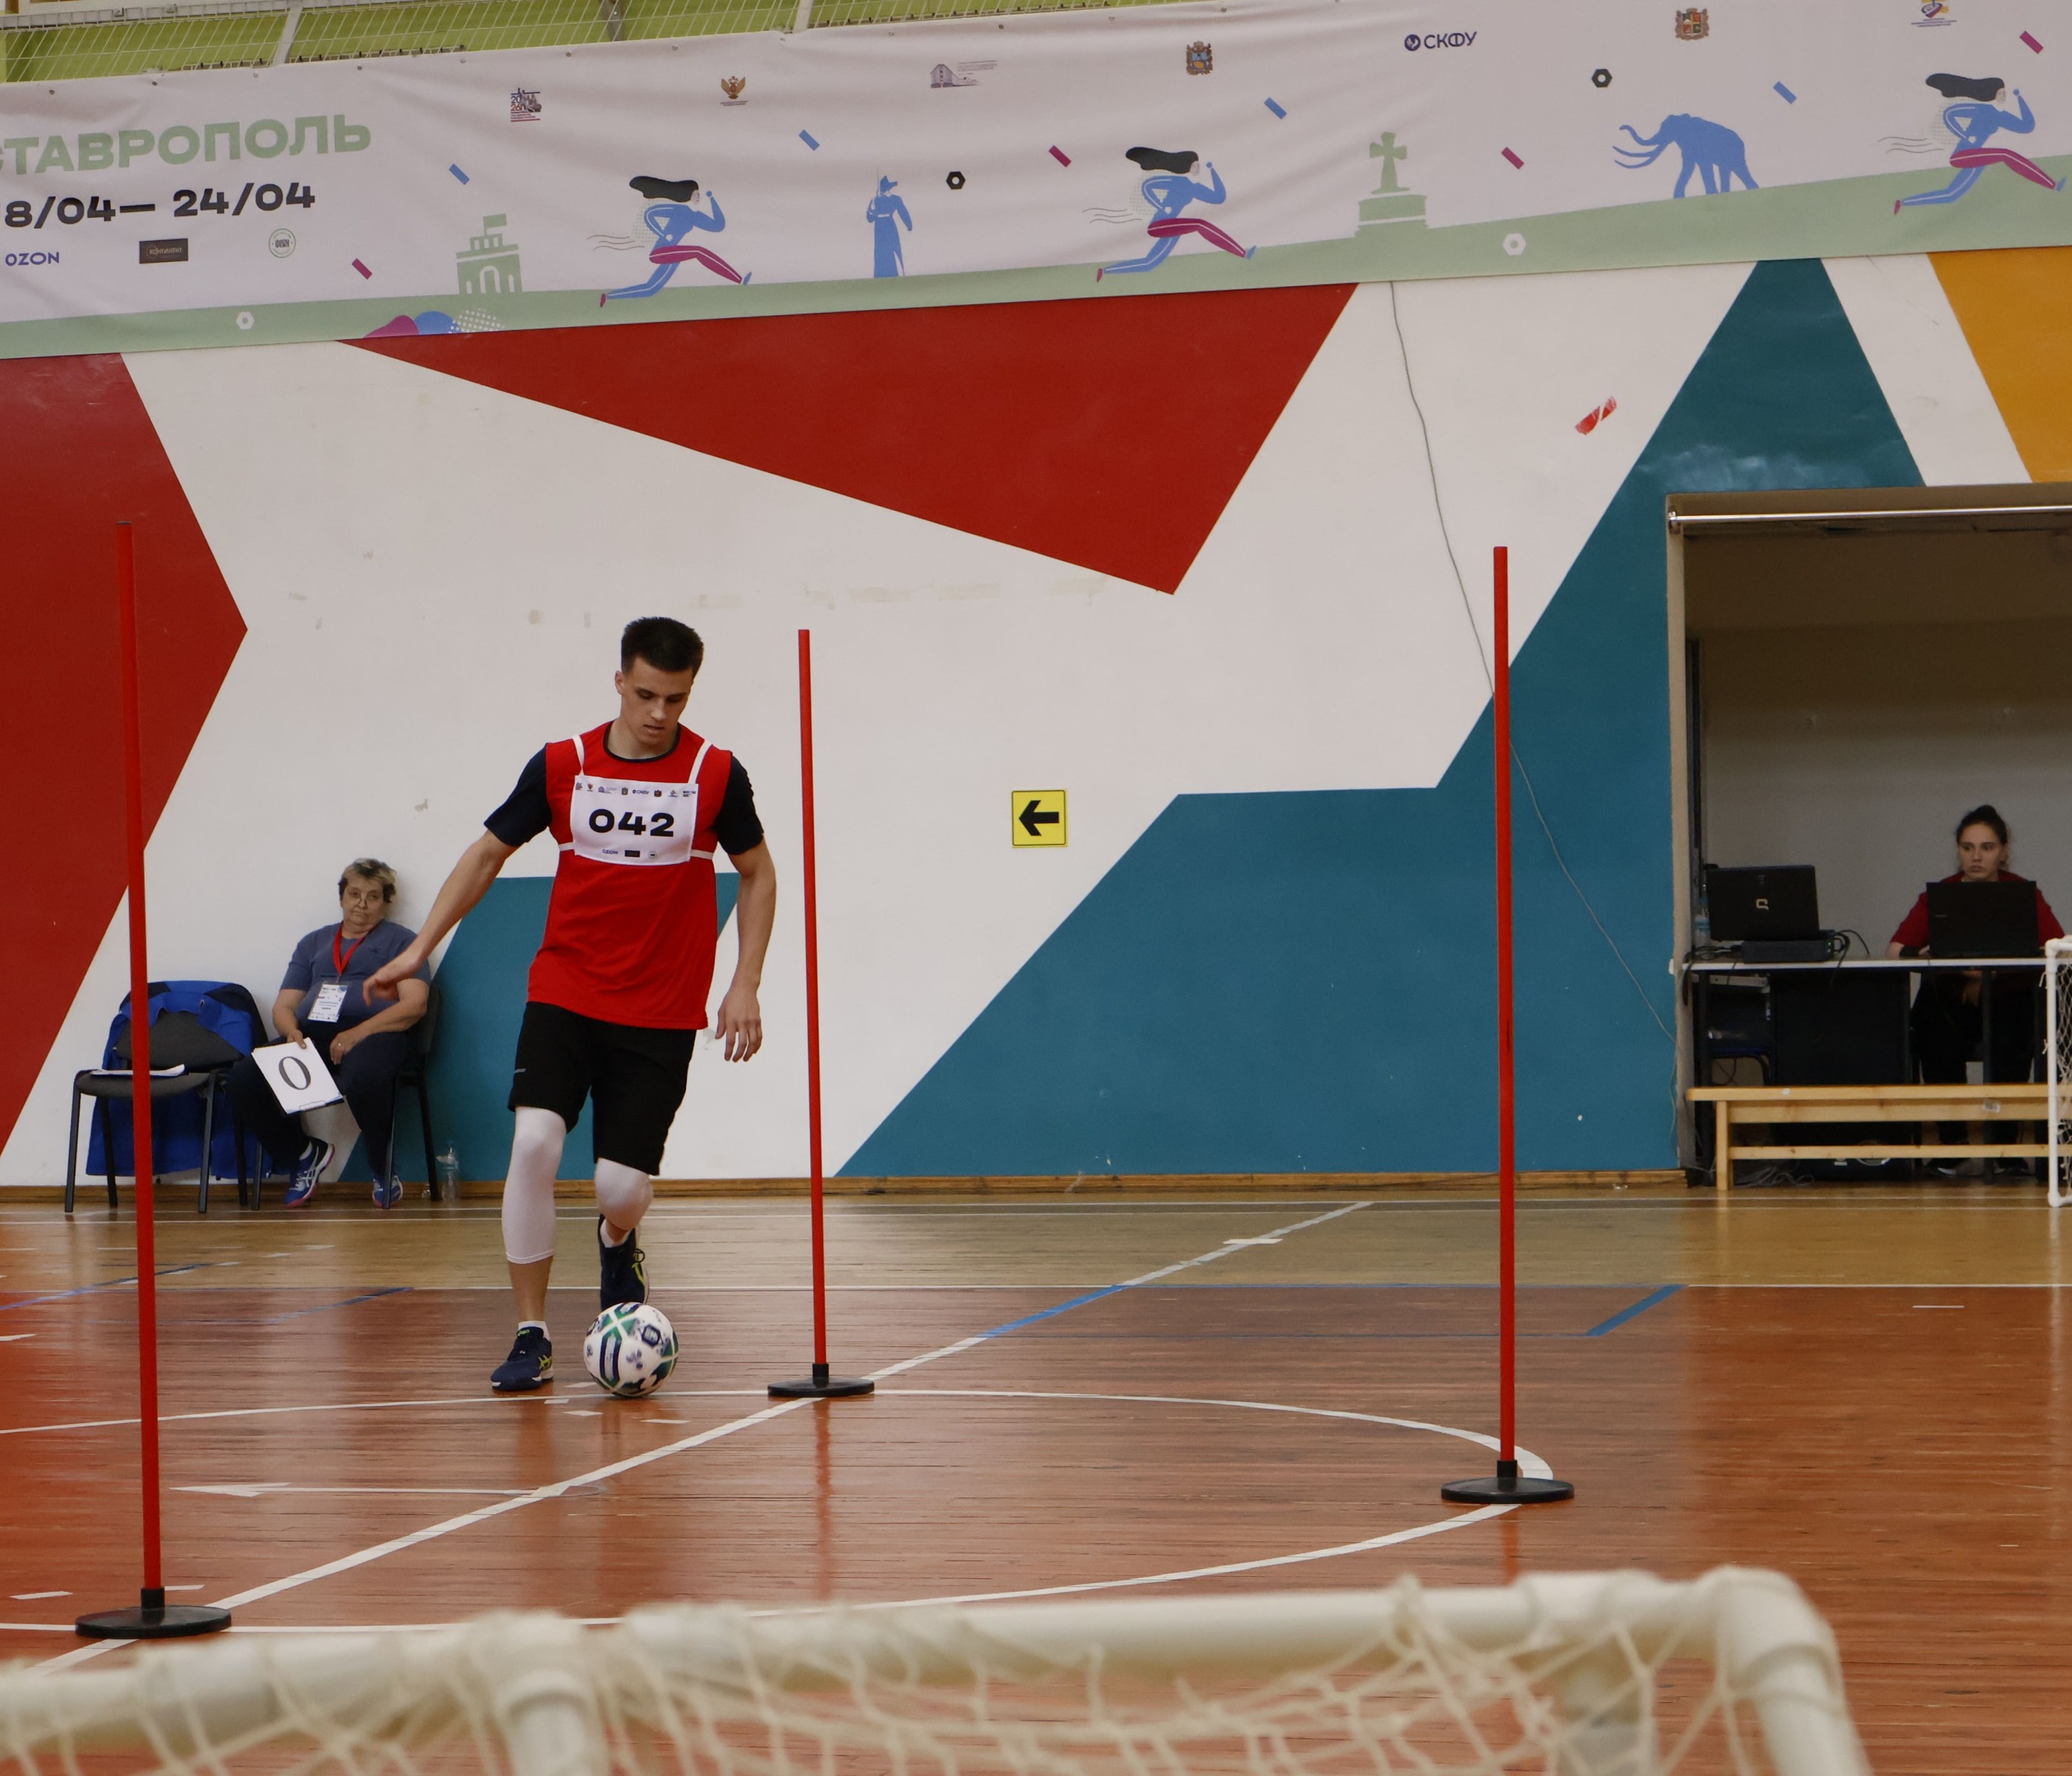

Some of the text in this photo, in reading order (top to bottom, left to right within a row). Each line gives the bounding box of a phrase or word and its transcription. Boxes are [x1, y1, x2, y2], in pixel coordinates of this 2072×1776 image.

[1424, 31, 1477, 50] СКФУ
[0, 114, 371, 175] ТАВРОПОЛЬ
[172, 182, 316, 218] 24/04
[5, 252, 60, 266] OZON
[588, 808, 674, 838] 042
